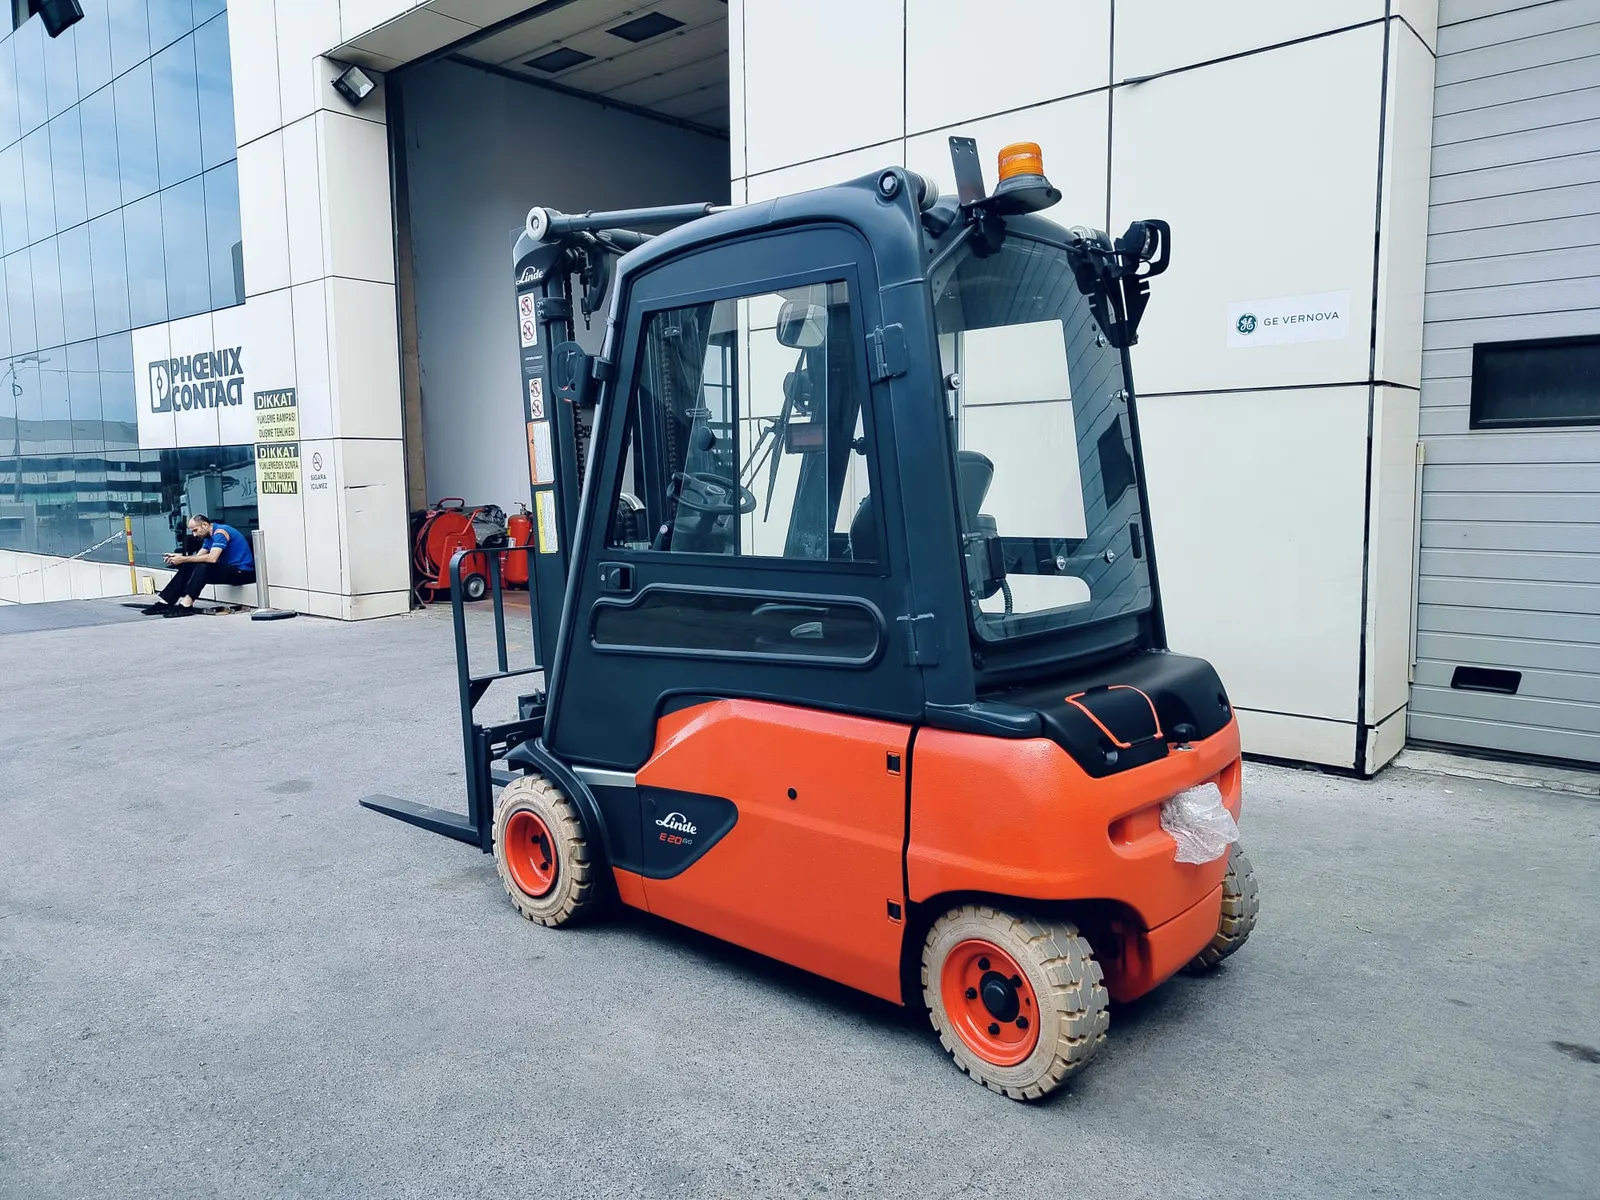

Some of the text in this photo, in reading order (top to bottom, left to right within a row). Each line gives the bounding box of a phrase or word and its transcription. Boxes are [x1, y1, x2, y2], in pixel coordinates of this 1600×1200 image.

[516, 266, 544, 285] Linde
[1263, 311, 1340, 326] GE VERNOVA
[172, 377, 245, 412] CONTACT
[257, 392, 293, 409] DİKKAT
[260, 444, 295, 458] DİKKAT
[263, 481, 296, 493] UNUTMA!
[655, 812, 697, 835] Linde
